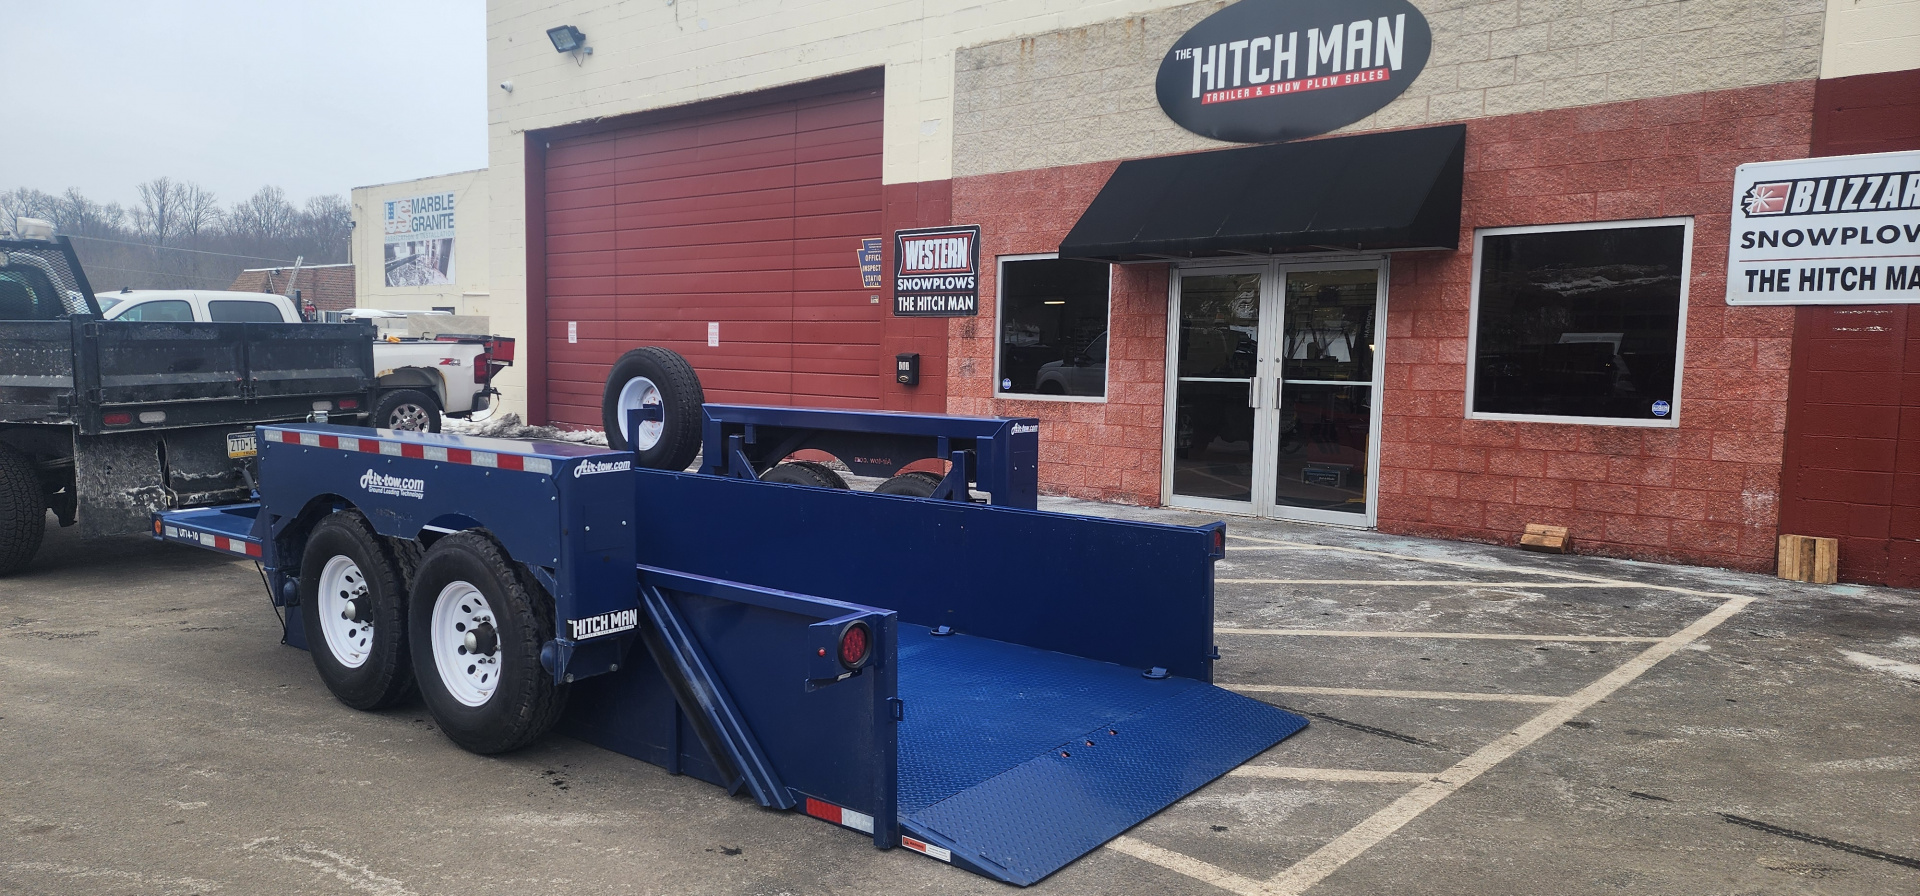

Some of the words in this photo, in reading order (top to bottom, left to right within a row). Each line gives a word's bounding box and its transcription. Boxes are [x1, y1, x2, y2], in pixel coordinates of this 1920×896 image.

[1175, 47, 1192, 61] THE
[1192, 31, 1298, 98] HITCH
[1307, 13, 1406, 76] MAN
[1206, 88, 1250, 103] TRAILER
[1256, 86, 1263, 96] &
[1270, 81, 1301, 94] SNOW
[1307, 76, 1339, 89] PLOW
[1345, 70, 1384, 84] SALES
[411, 193, 454, 214] MARBLE
[411, 213, 454, 232] GRANITE
[904, 237, 968, 270] WESTERN
[897, 276, 975, 291] SNOWPLOWS
[1745, 268, 1791, 293] THE
[1798, 266, 1877, 292] HITCH
[898, 296, 915, 311] THE
[917, 296, 945, 311] HITCH
[947, 295, 974, 311] MAN
[360, 468, 424, 490] Air-tow.com
[573, 459, 631, 478] Air-tow.com
[383, 487, 399, 496] Loading
[400, 490, 424, 499] Technology
[573, 614, 609, 639] HITCH
[610, 608, 638, 629] MAN
